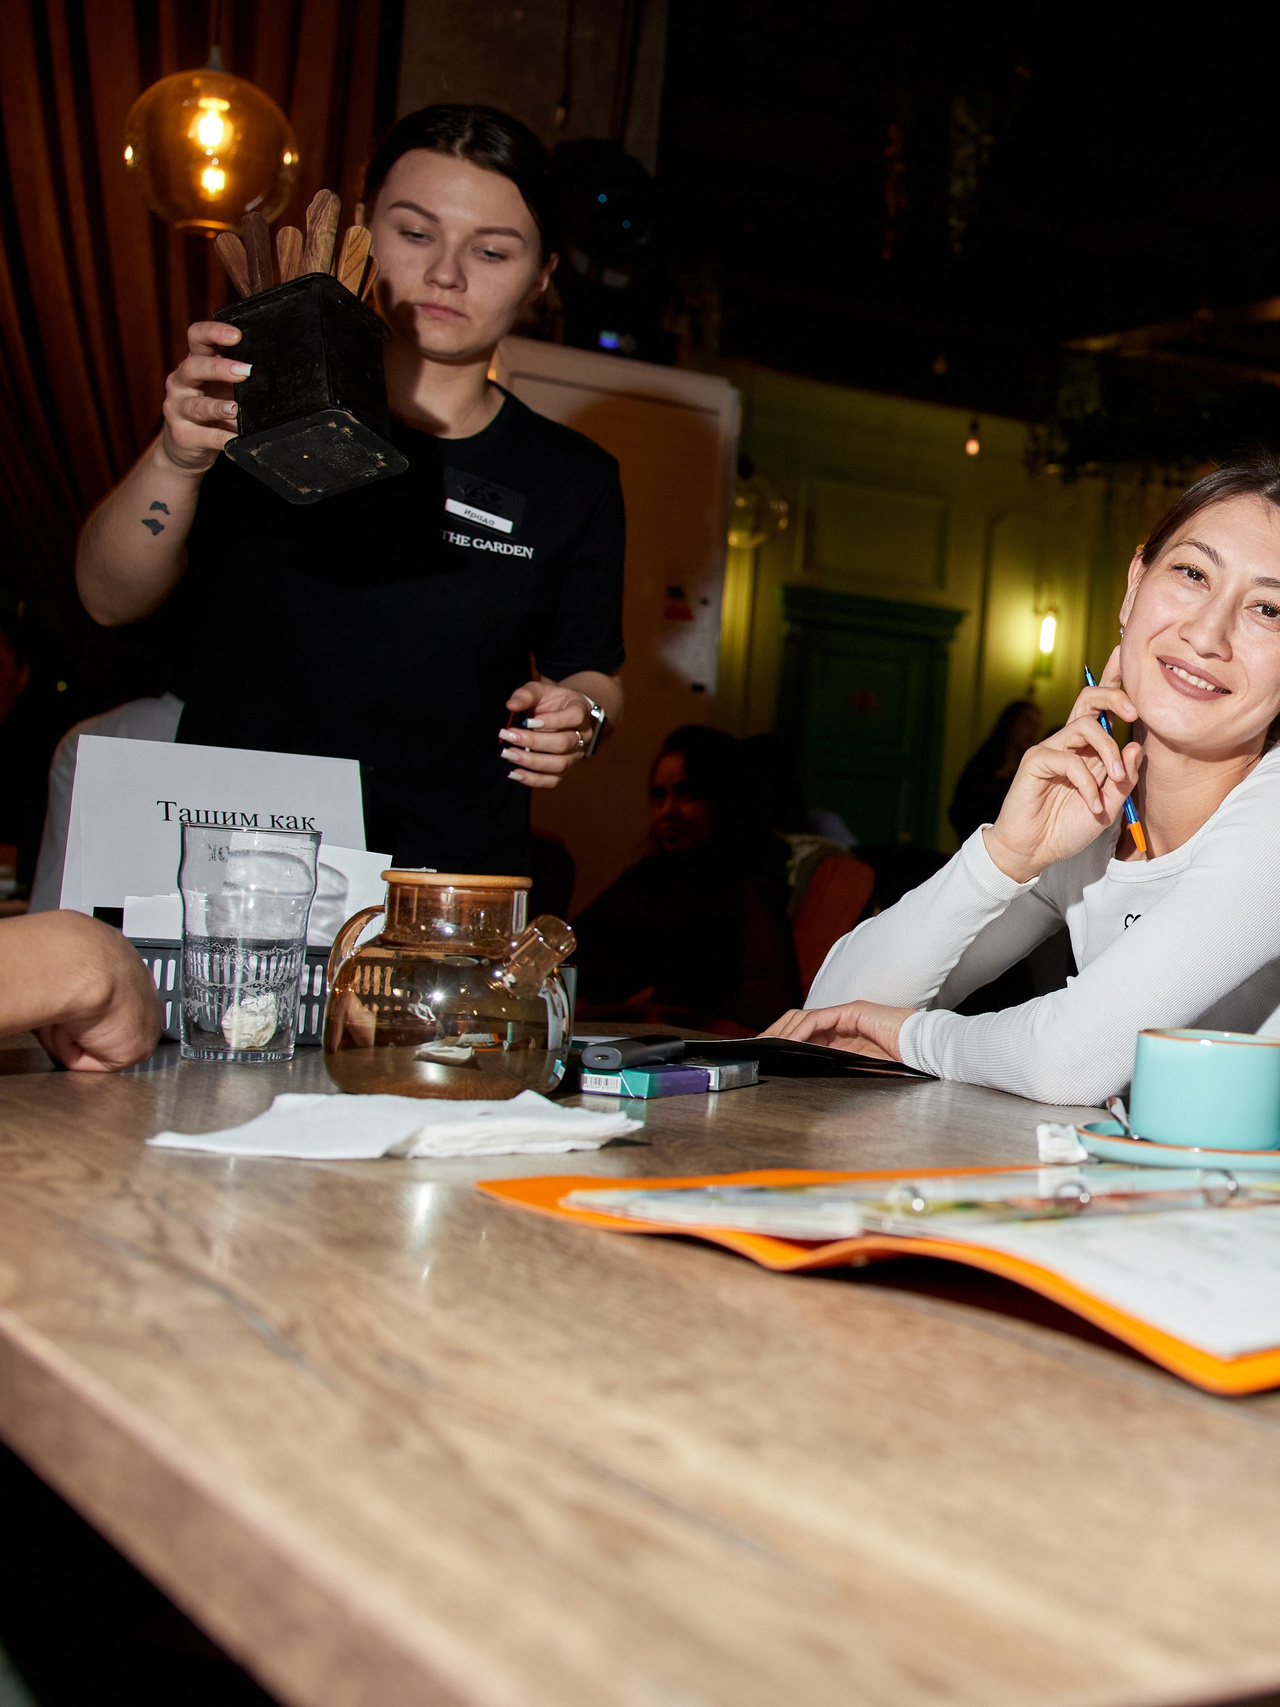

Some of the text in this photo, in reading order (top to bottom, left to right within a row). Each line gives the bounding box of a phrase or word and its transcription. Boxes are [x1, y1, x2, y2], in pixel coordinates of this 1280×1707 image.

[440, 529, 534, 559] THE GARDEN
[270, 814, 316, 831] как
